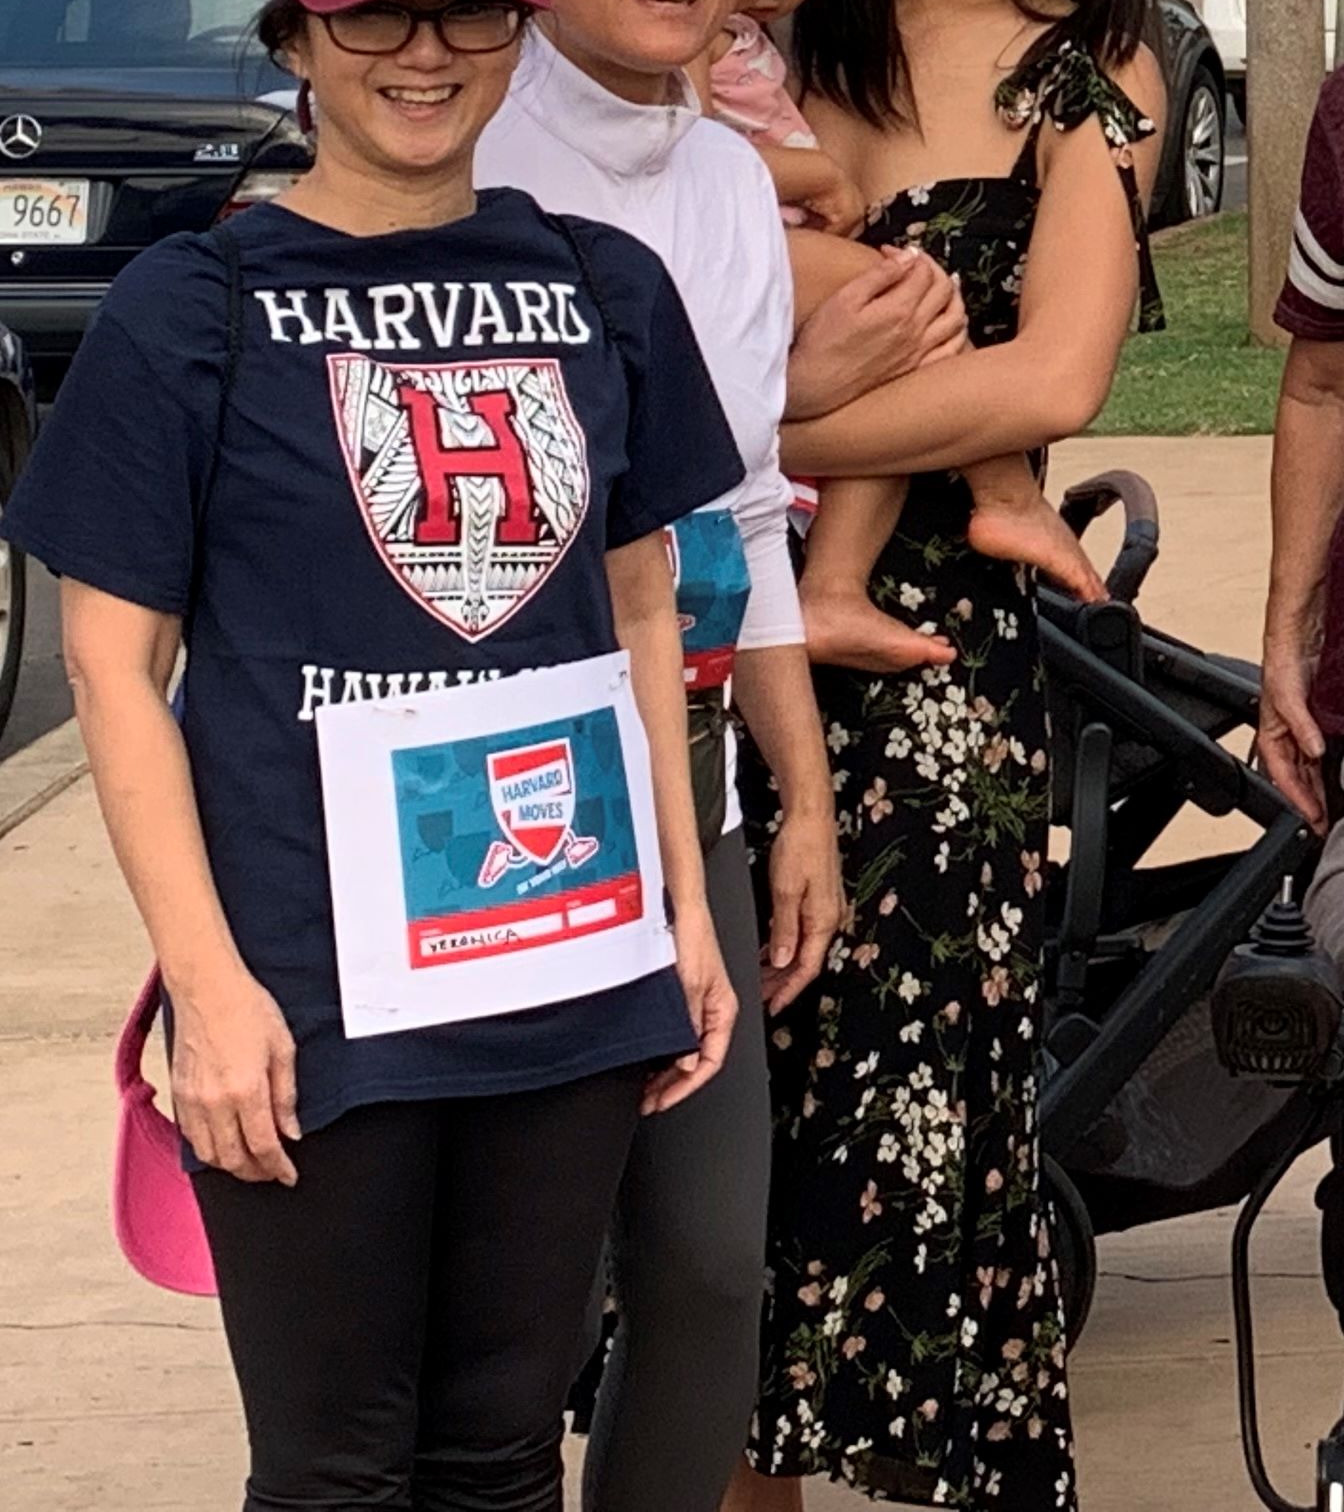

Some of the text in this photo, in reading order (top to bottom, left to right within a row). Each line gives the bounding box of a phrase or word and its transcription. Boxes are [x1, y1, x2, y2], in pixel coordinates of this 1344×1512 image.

[13, 194, 80, 227] 9667
[254, 281, 591, 350] HARVARD
[501, 769, 564, 803] HARVARD
[518, 801, 564, 822] MOVES
[429, 927, 523, 954] VERONICA
